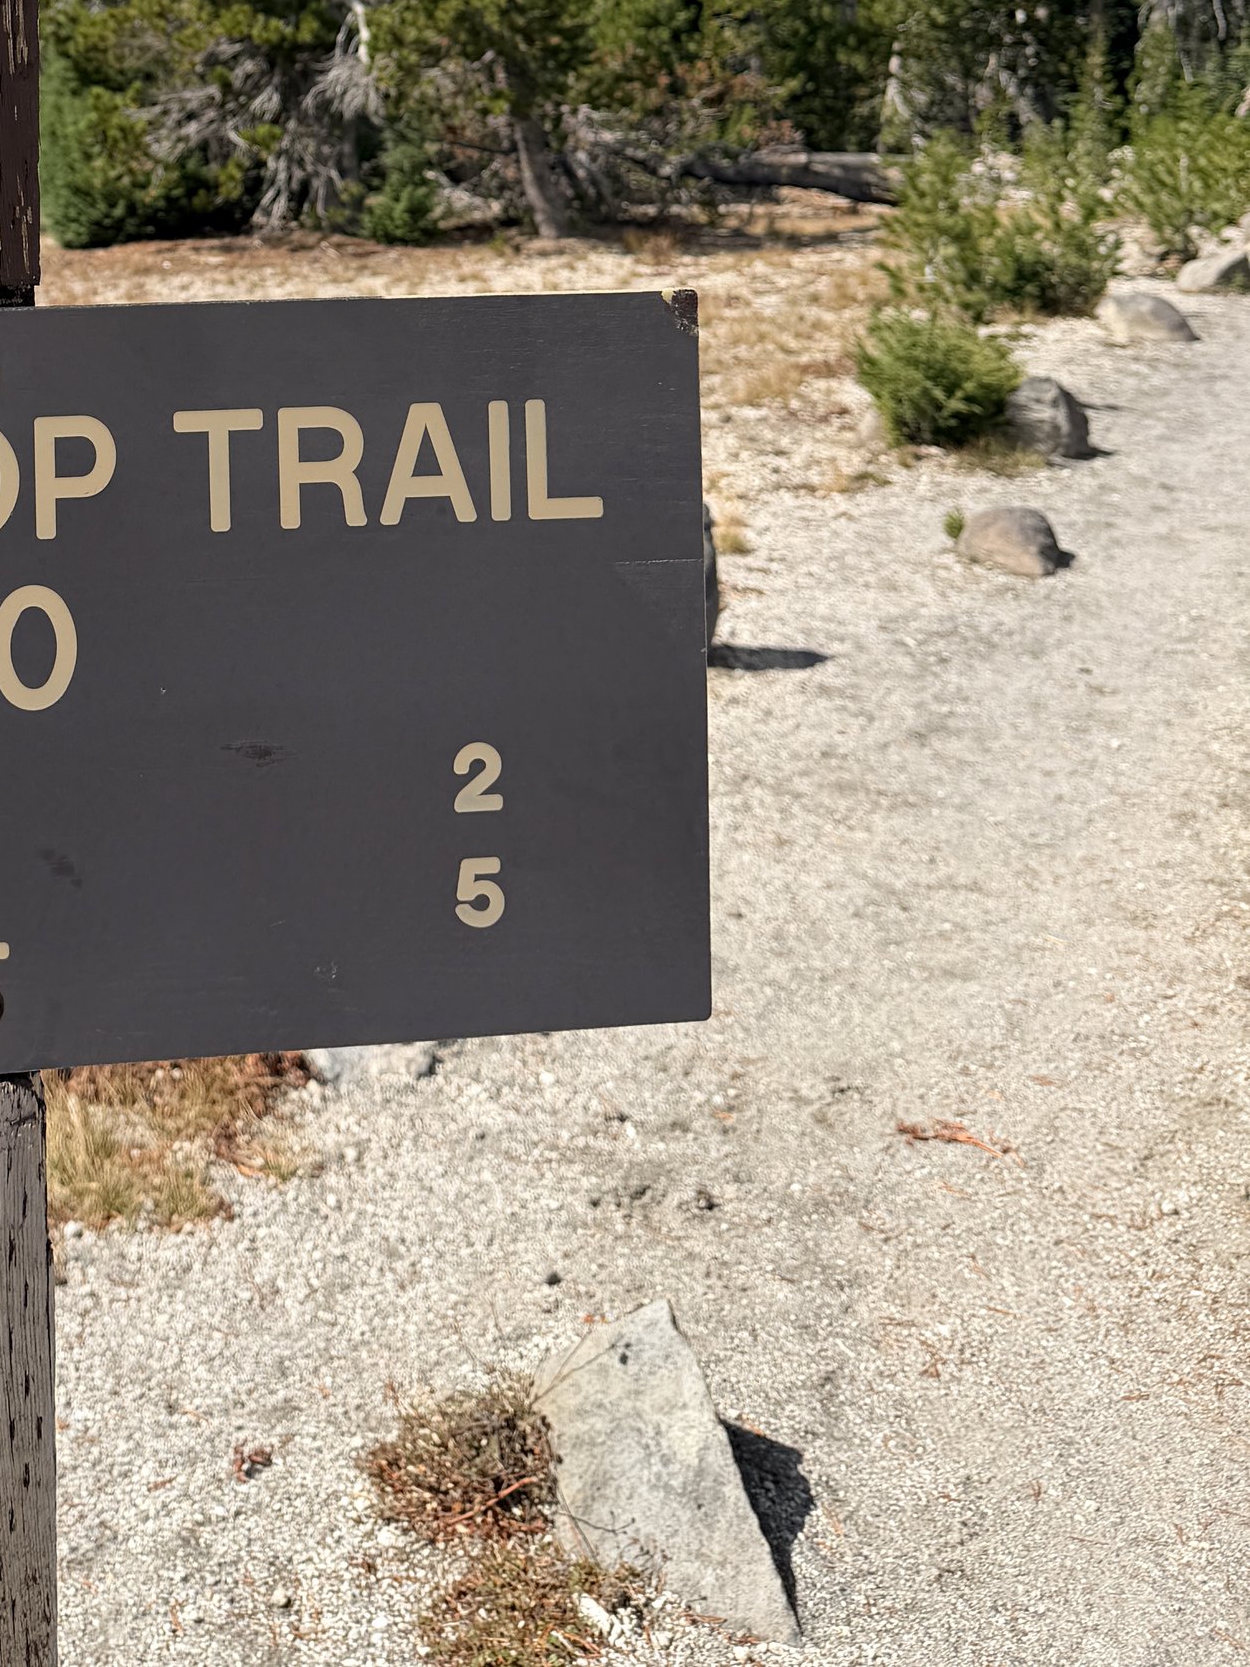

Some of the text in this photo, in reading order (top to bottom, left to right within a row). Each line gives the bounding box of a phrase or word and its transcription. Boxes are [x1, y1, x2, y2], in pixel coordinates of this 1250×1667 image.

[173, 400, 603, 532] TRAIL
[454, 742, 503, 812] 2
[456, 857, 504, 927] 5
